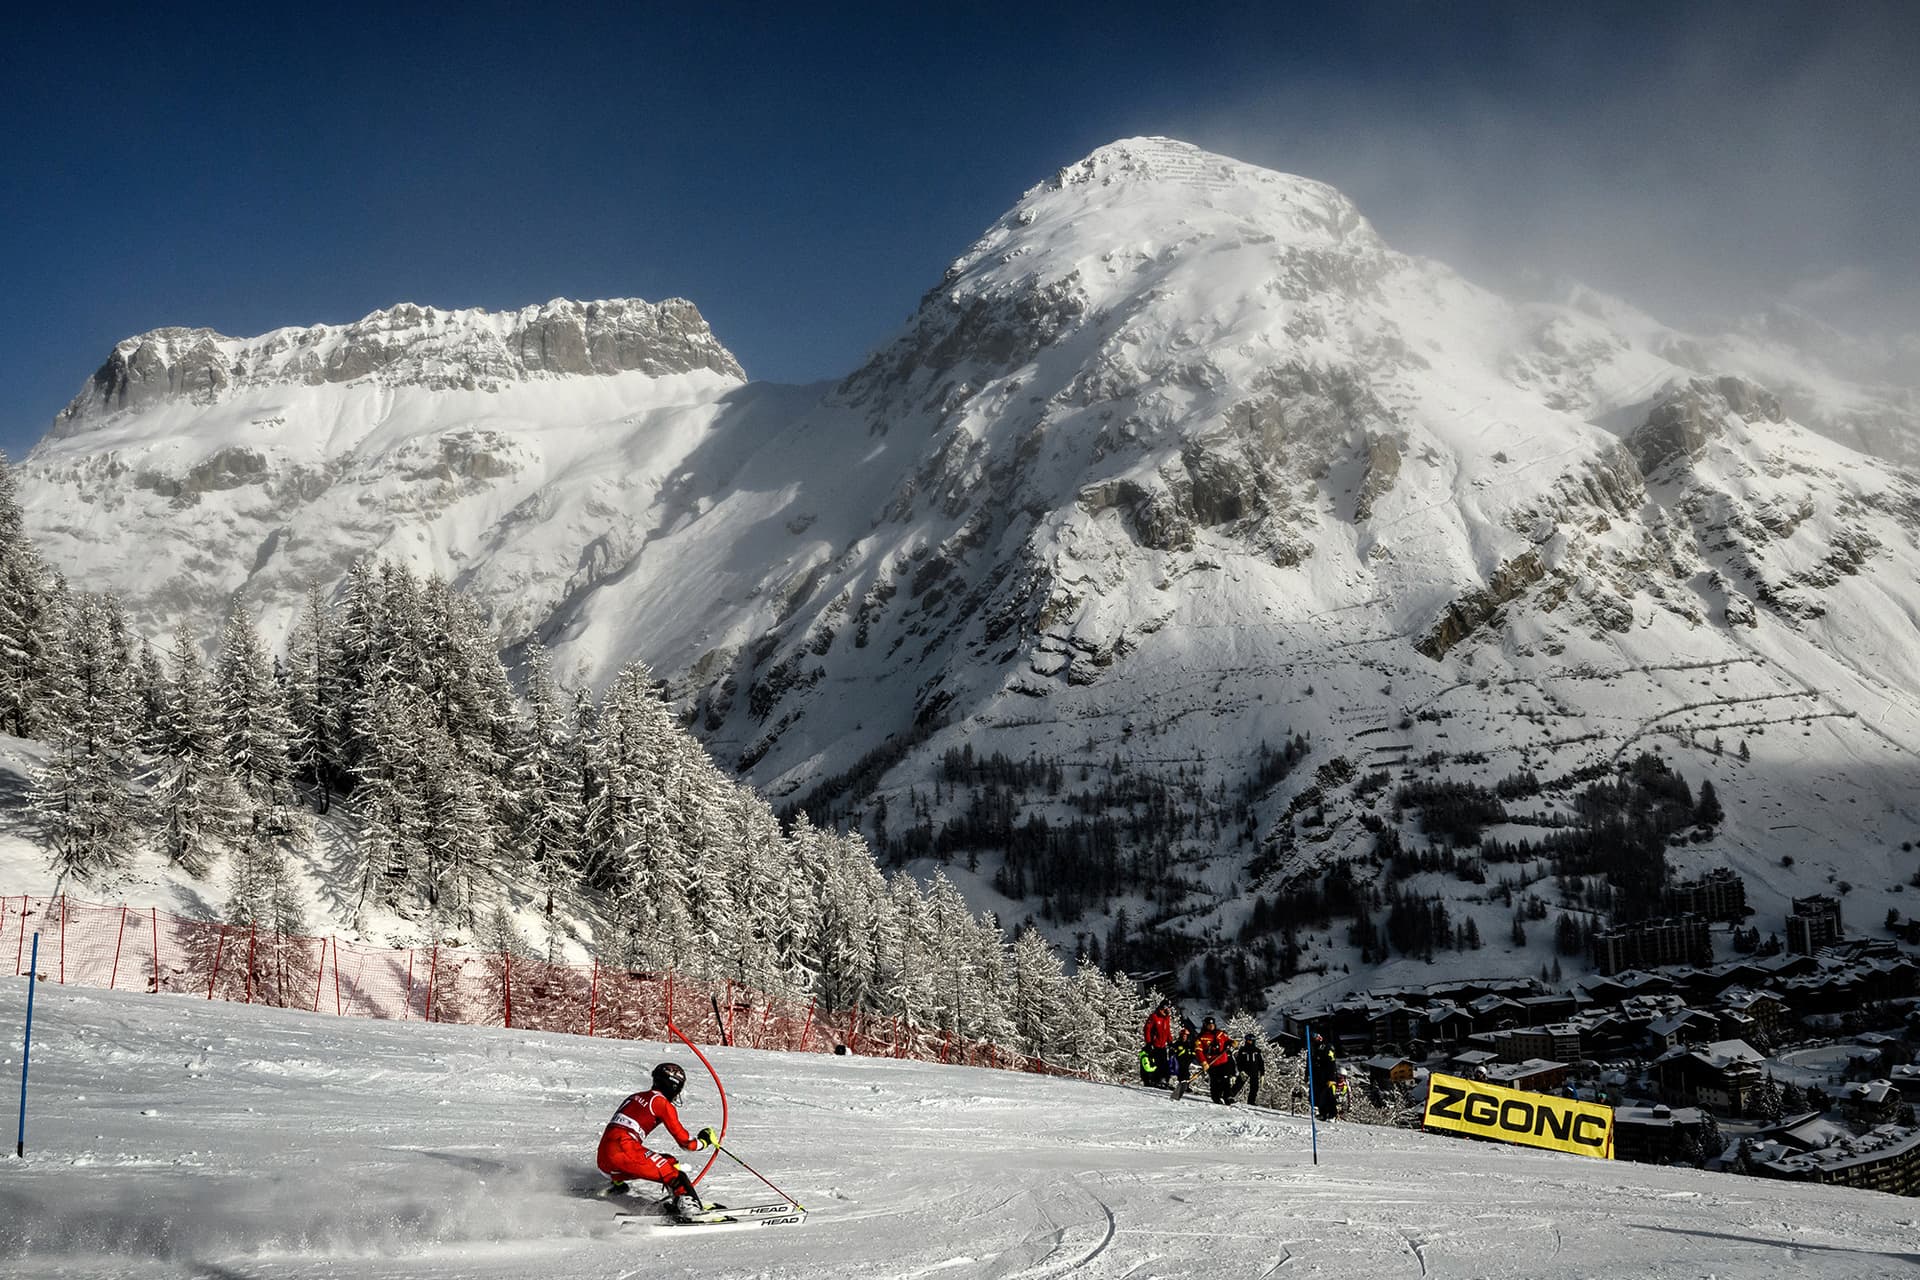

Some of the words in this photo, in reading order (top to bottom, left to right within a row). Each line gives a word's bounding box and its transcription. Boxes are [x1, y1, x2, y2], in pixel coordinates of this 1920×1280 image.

[1429, 1085, 1606, 1147] ZGONC
[750, 1206, 788, 1214] HEAD
[761, 1217, 799, 1226] HEAD
